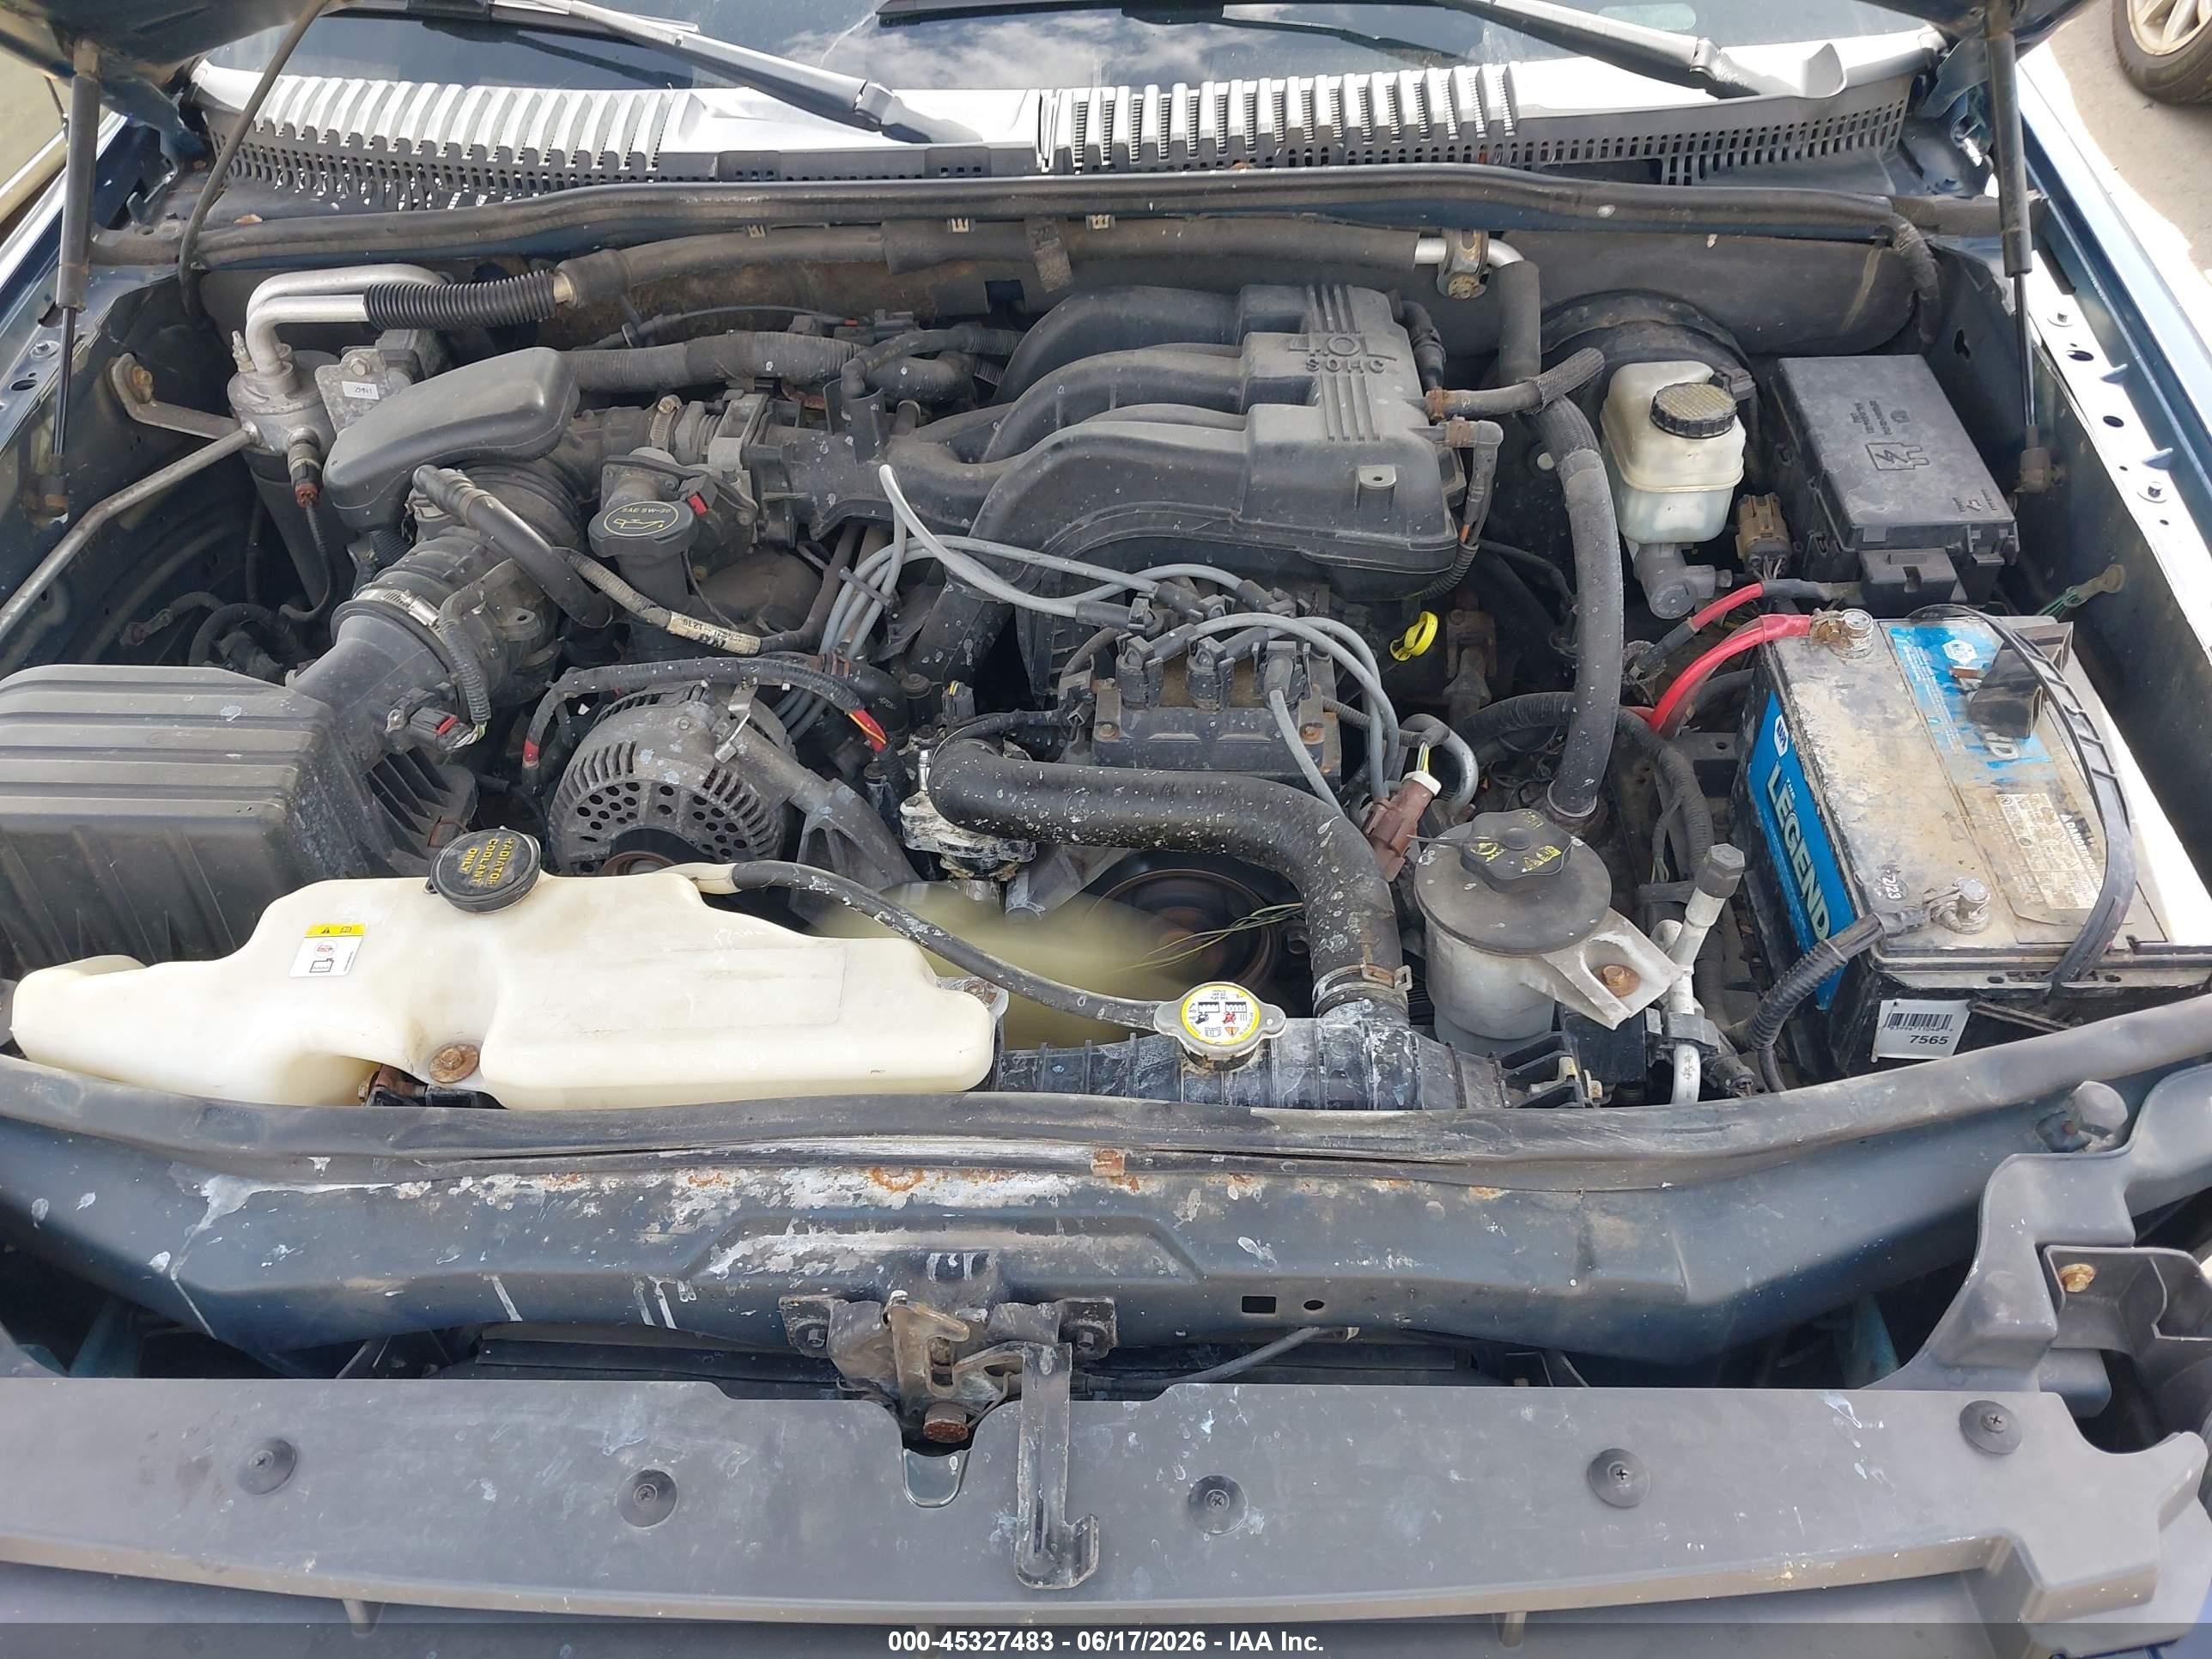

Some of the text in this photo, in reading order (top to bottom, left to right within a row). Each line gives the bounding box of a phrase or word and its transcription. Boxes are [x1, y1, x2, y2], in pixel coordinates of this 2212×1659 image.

[1288, 335, 1397, 362] 4.0L
[1305, 357, 1386, 374] SOHC
[459, 848, 478, 872] ONLY
[471, 838, 499, 884] COOLANT
[487, 837, 515, 886] RADIATOR
[1767, 761, 1831, 940] LEGEND
[1909, 1035, 1949, 1045] 7565
